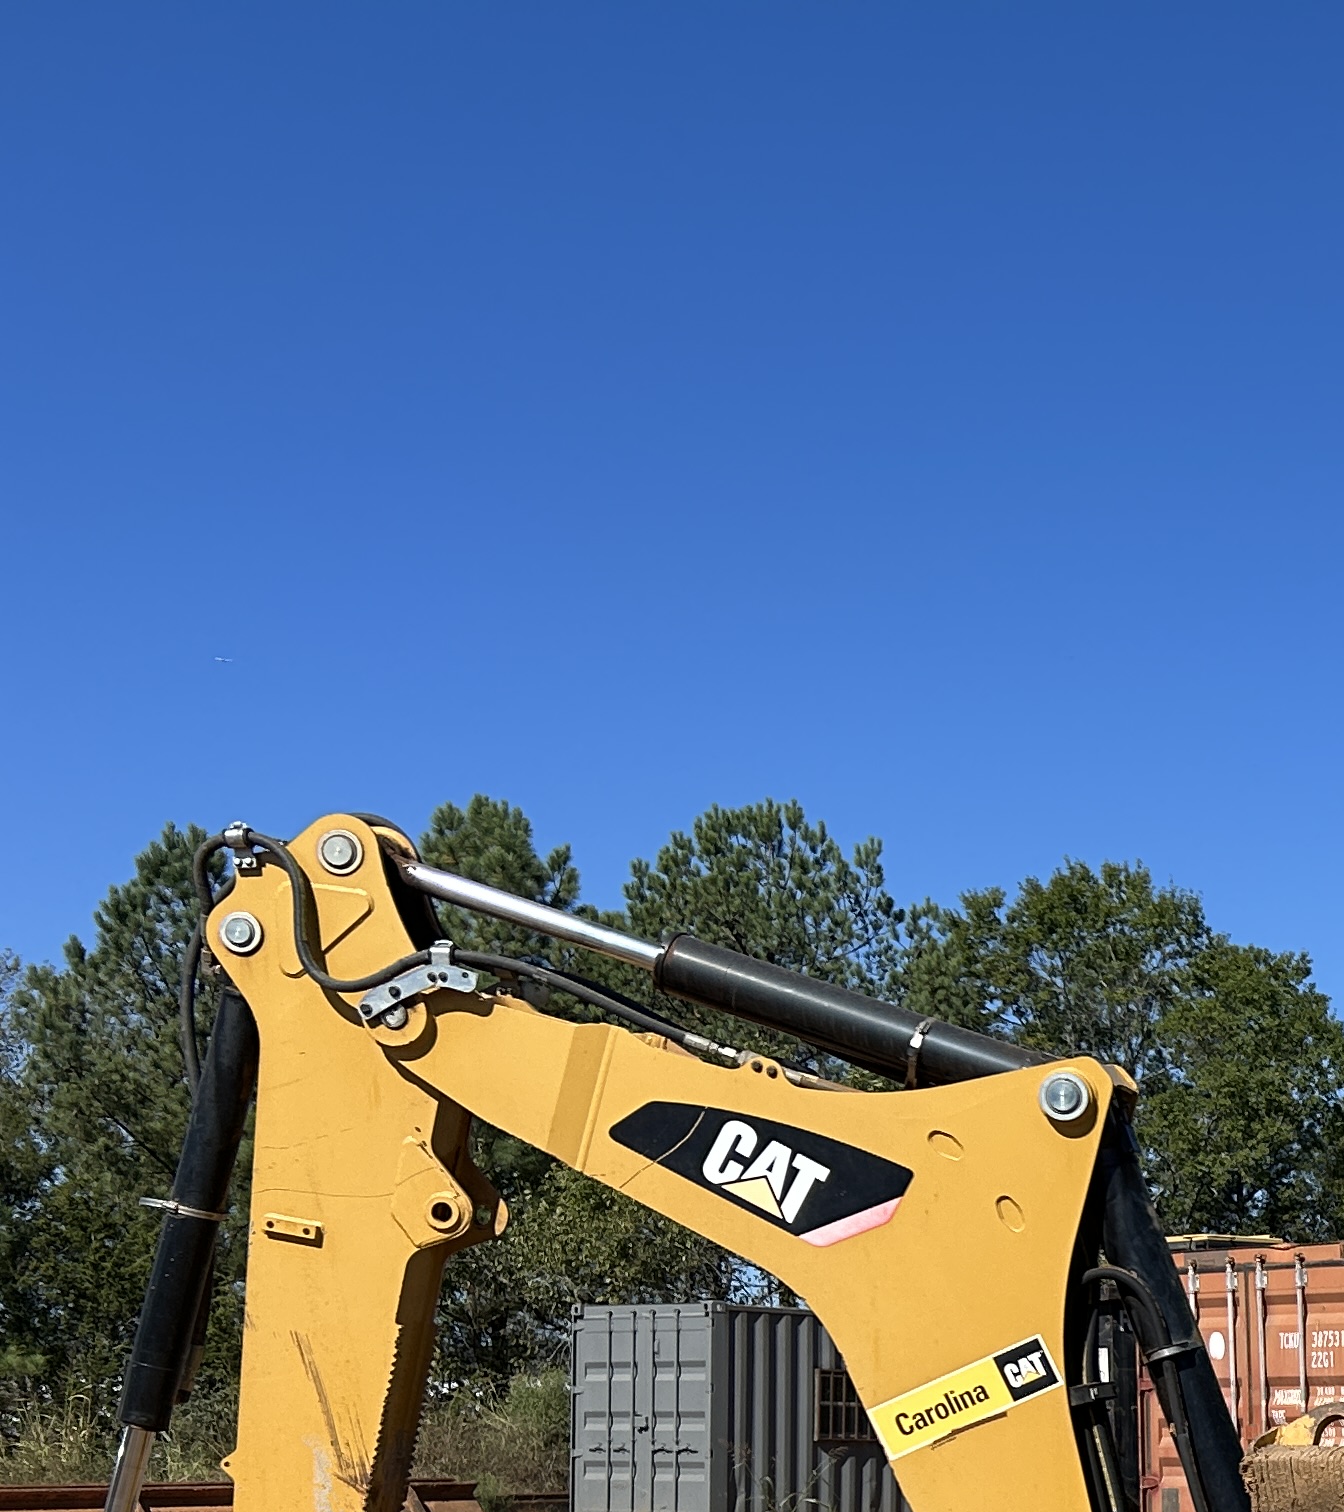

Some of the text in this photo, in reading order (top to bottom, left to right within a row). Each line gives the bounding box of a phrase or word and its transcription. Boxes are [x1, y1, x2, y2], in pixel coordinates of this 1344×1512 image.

[703, 1120, 831, 1224] CAT
[1311, 1330, 1344, 1348] 387531
[1311, 1350, 1334, 1369] 22G1
[895, 1350, 1047, 1436] Carolina CAT
